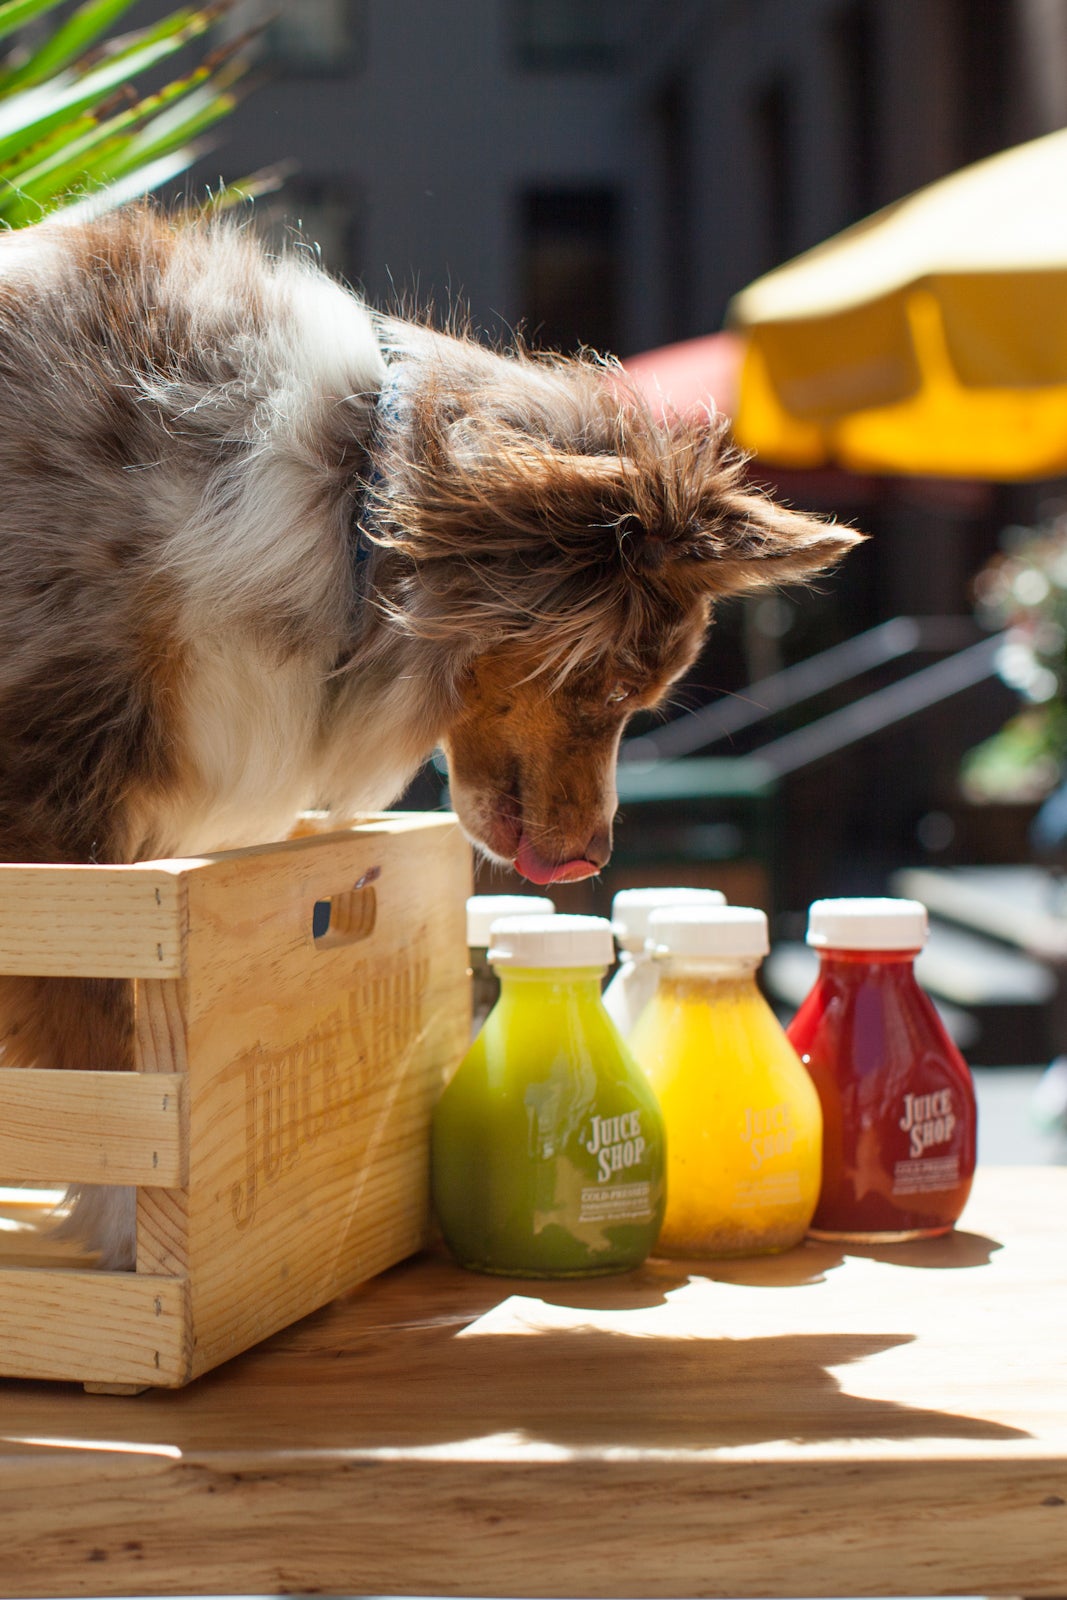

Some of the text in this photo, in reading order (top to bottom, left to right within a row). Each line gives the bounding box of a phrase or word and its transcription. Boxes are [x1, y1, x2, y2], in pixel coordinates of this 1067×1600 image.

[586, 1109, 641, 1155] JUICE
[900, 1088, 951, 1132] JUICE
[750, 1127, 797, 1171] SHOP
[910, 1112, 955, 1158] SHOP
[598, 1136, 645, 1182] SHOP
